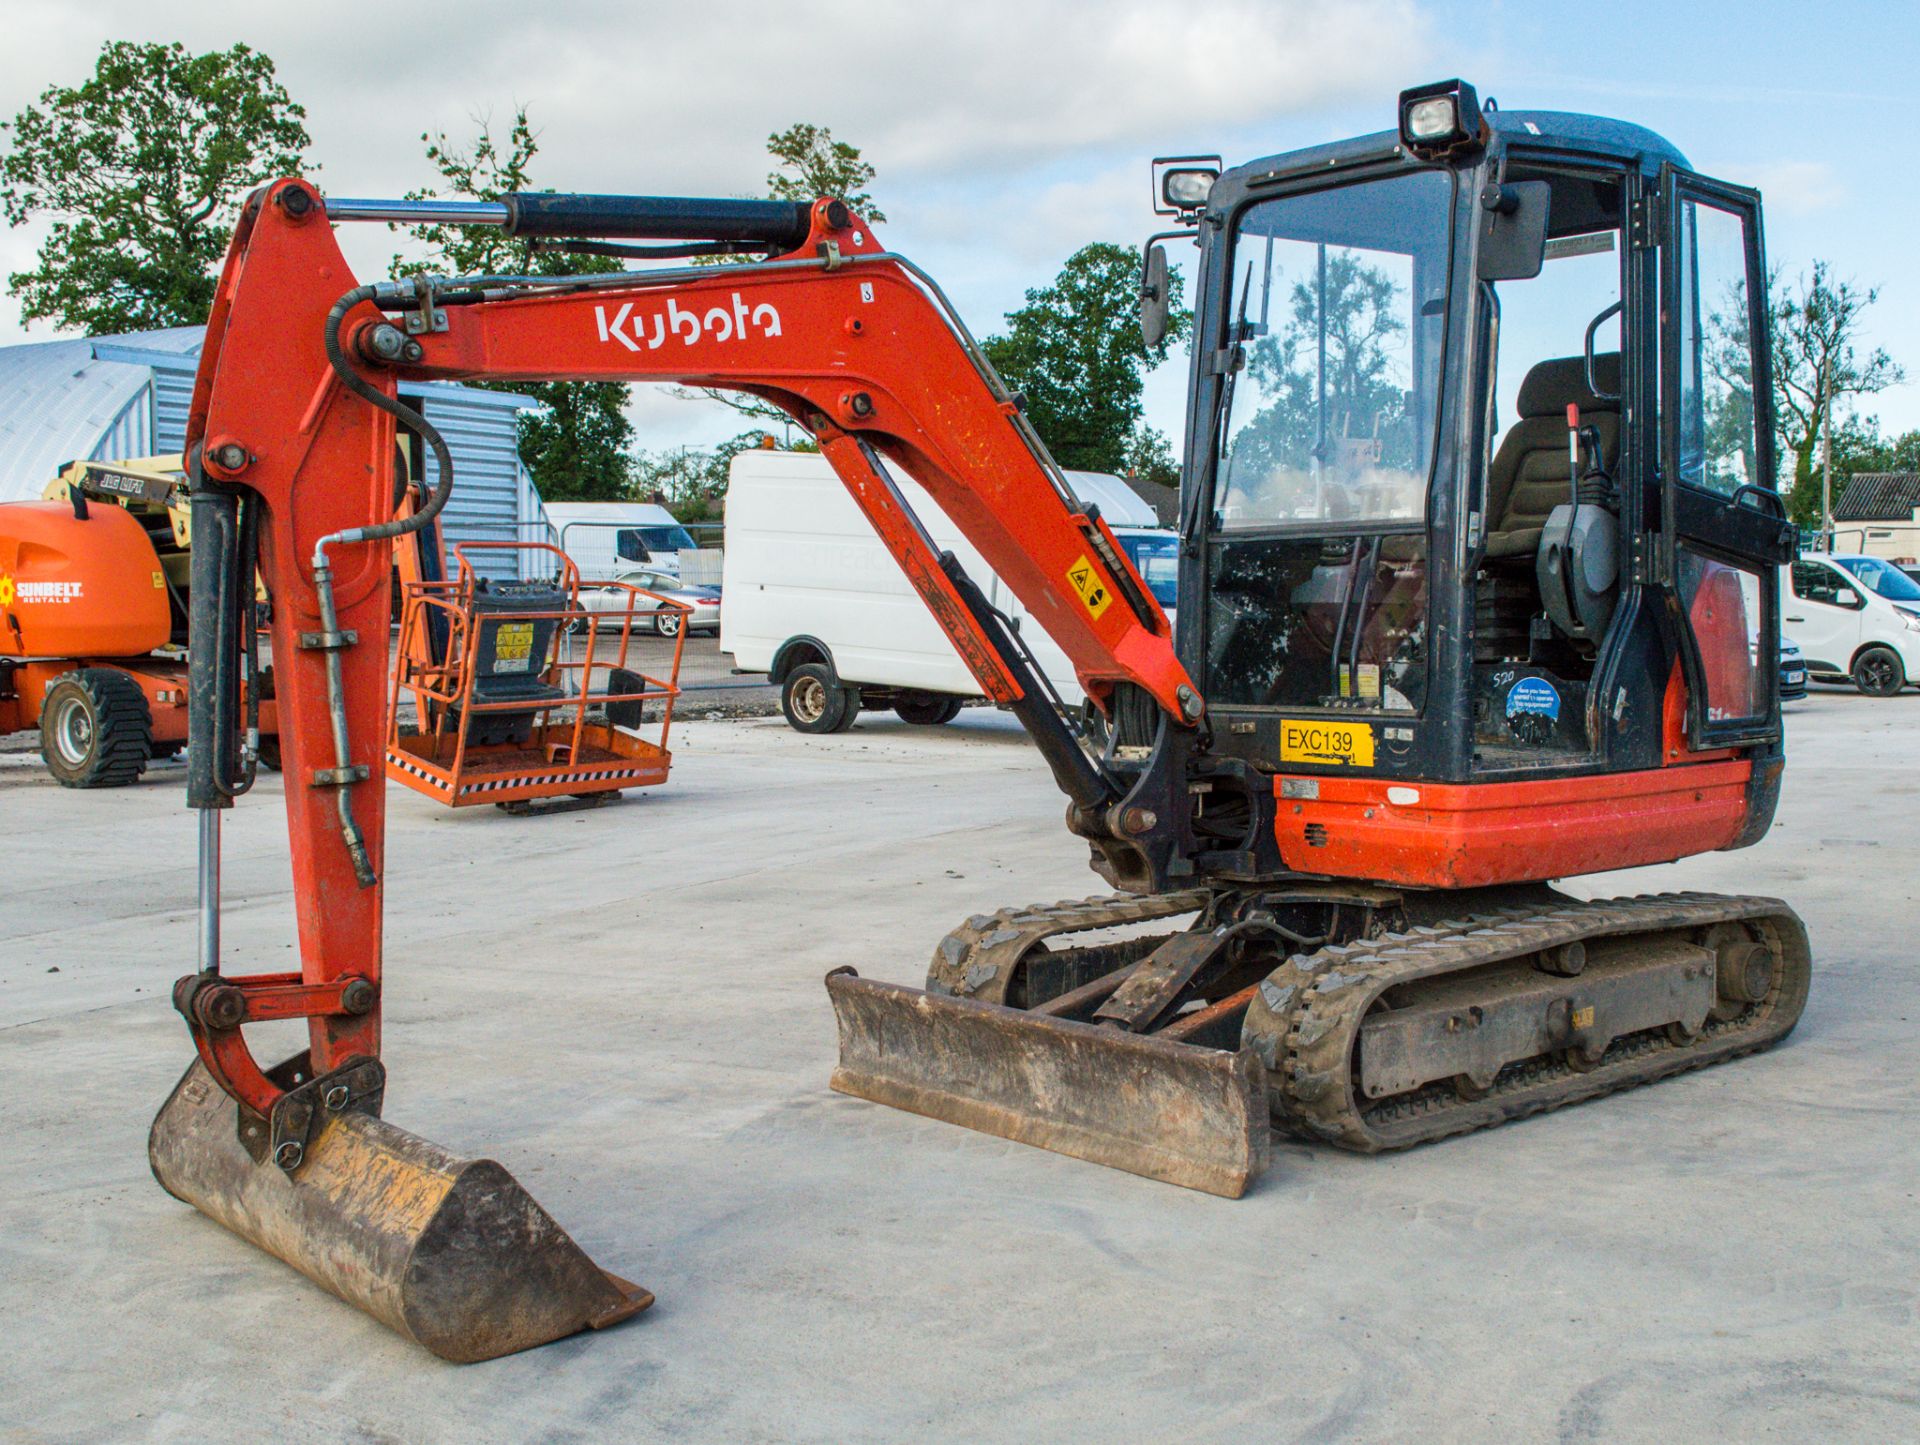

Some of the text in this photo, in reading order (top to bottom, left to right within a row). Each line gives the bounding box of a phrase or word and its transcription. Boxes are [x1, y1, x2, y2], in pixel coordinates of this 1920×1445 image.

[595, 292, 782, 351] Kubota
[100, 474, 144, 494] JLG LIFT
[17, 582, 82, 597] SUNBELT
[1287, 728, 1353, 752] EXC139
